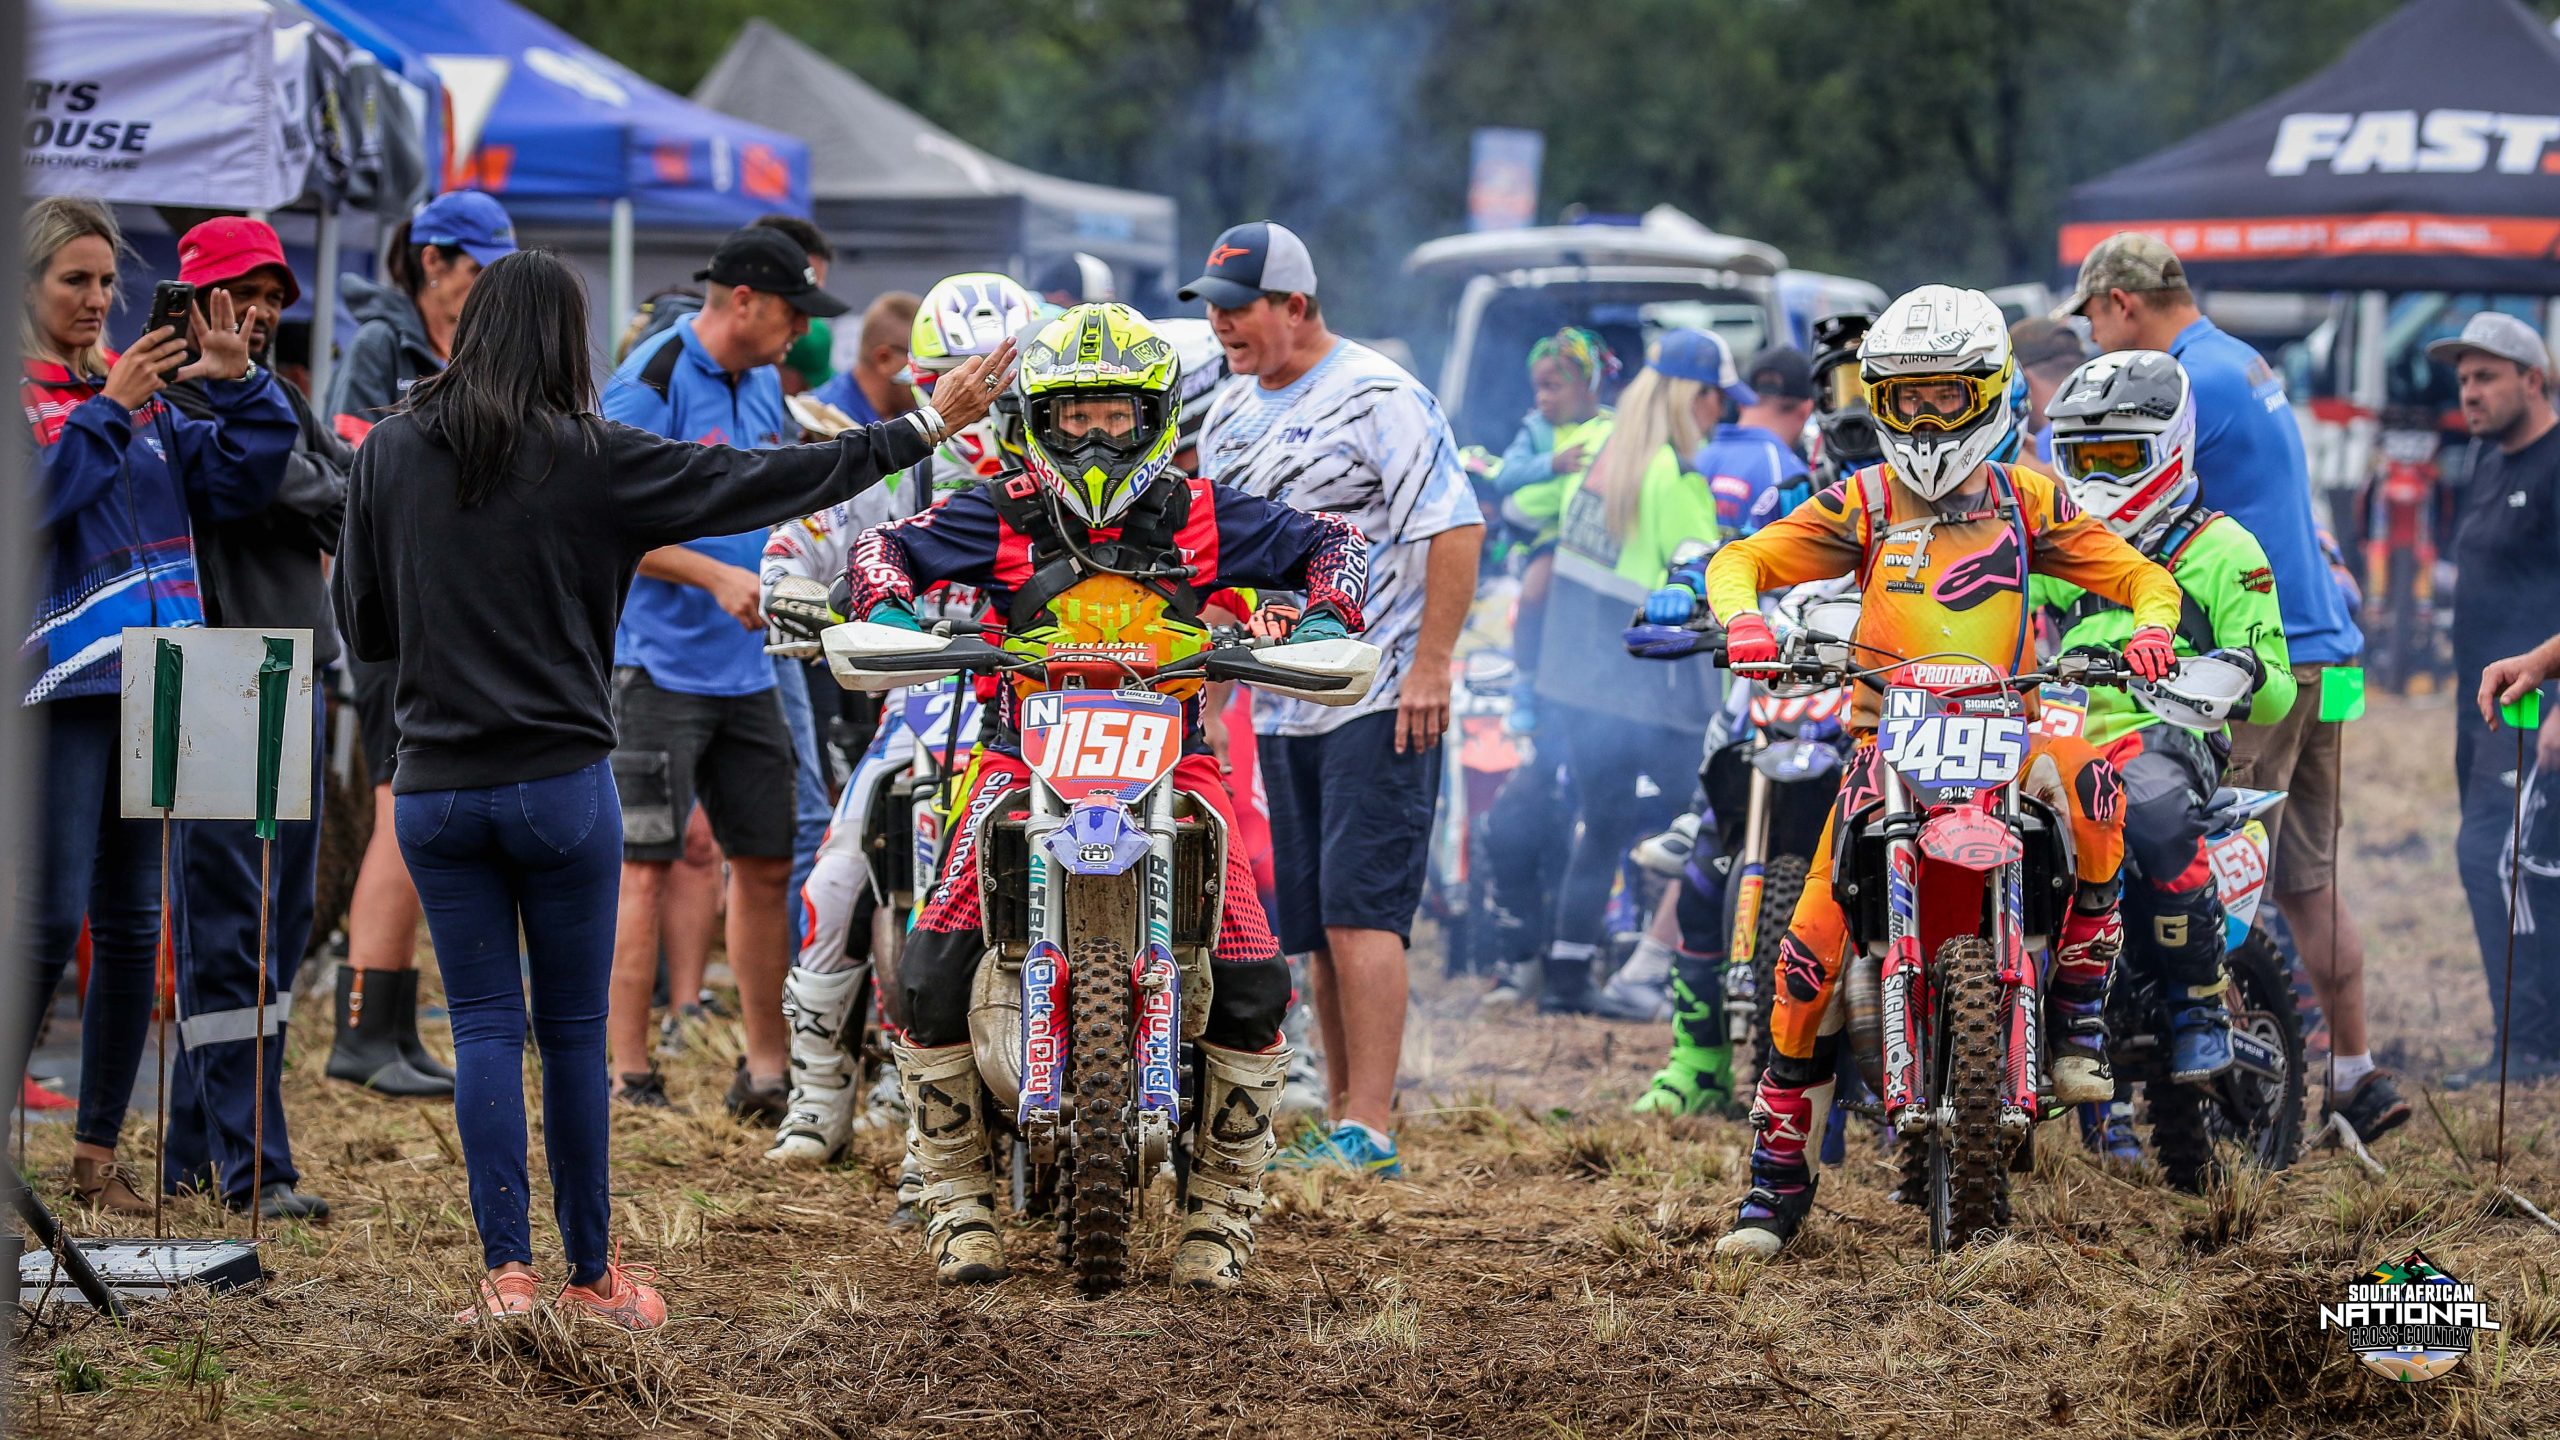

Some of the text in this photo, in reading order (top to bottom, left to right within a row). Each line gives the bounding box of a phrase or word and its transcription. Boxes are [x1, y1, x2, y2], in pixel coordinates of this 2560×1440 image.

[1928, 327, 1974, 351] AIROH
[1900, 354, 1938, 365] AIROH
[1917, 664, 1992, 685] PROTAPER
[1030, 699, 1058, 727] N
[1893, 692, 1921, 717] N
[1965, 699, 1996, 711] SIGMA
[1882, 717, 2025, 782] J495
[1885, 974, 1906, 1045] SIGMA
[2019, 995, 2037, 1093] invert
